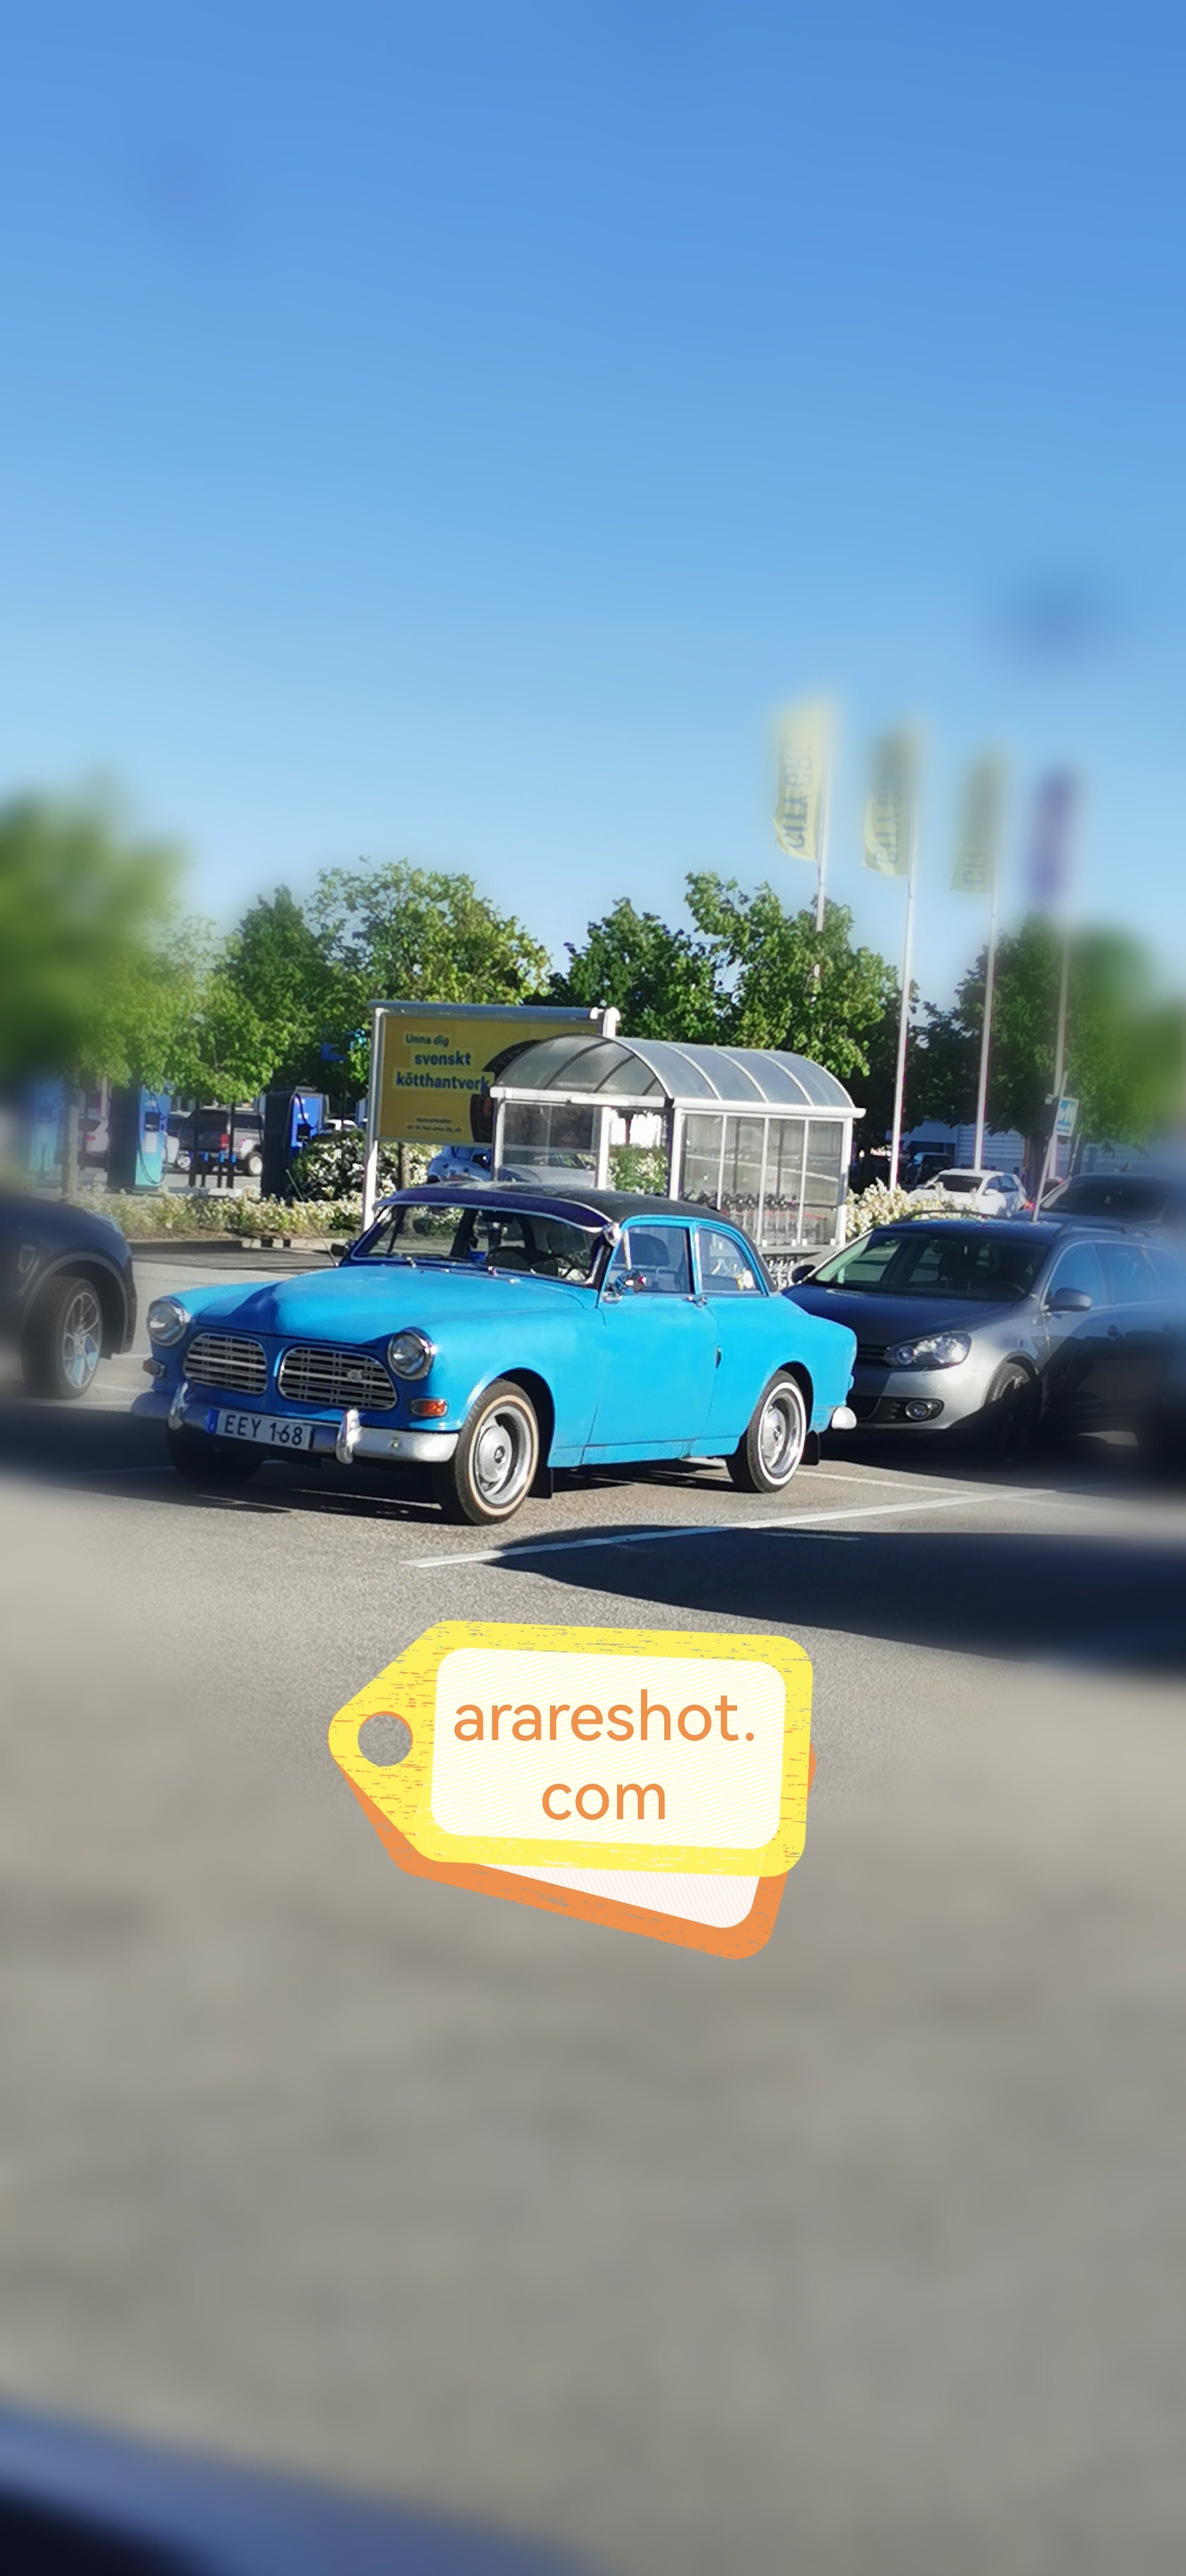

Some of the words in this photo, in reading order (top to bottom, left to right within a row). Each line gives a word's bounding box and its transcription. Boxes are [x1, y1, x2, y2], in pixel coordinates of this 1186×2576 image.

[405, 1033, 431, 1044] Unna
[433, 1034, 450, 1048] dig
[414, 1049, 471, 1066] svenskt
[396, 1071, 489, 1091] kötthantverk
[224, 1414, 262, 1438] EEY
[269, 1421, 303, 1446] 168
